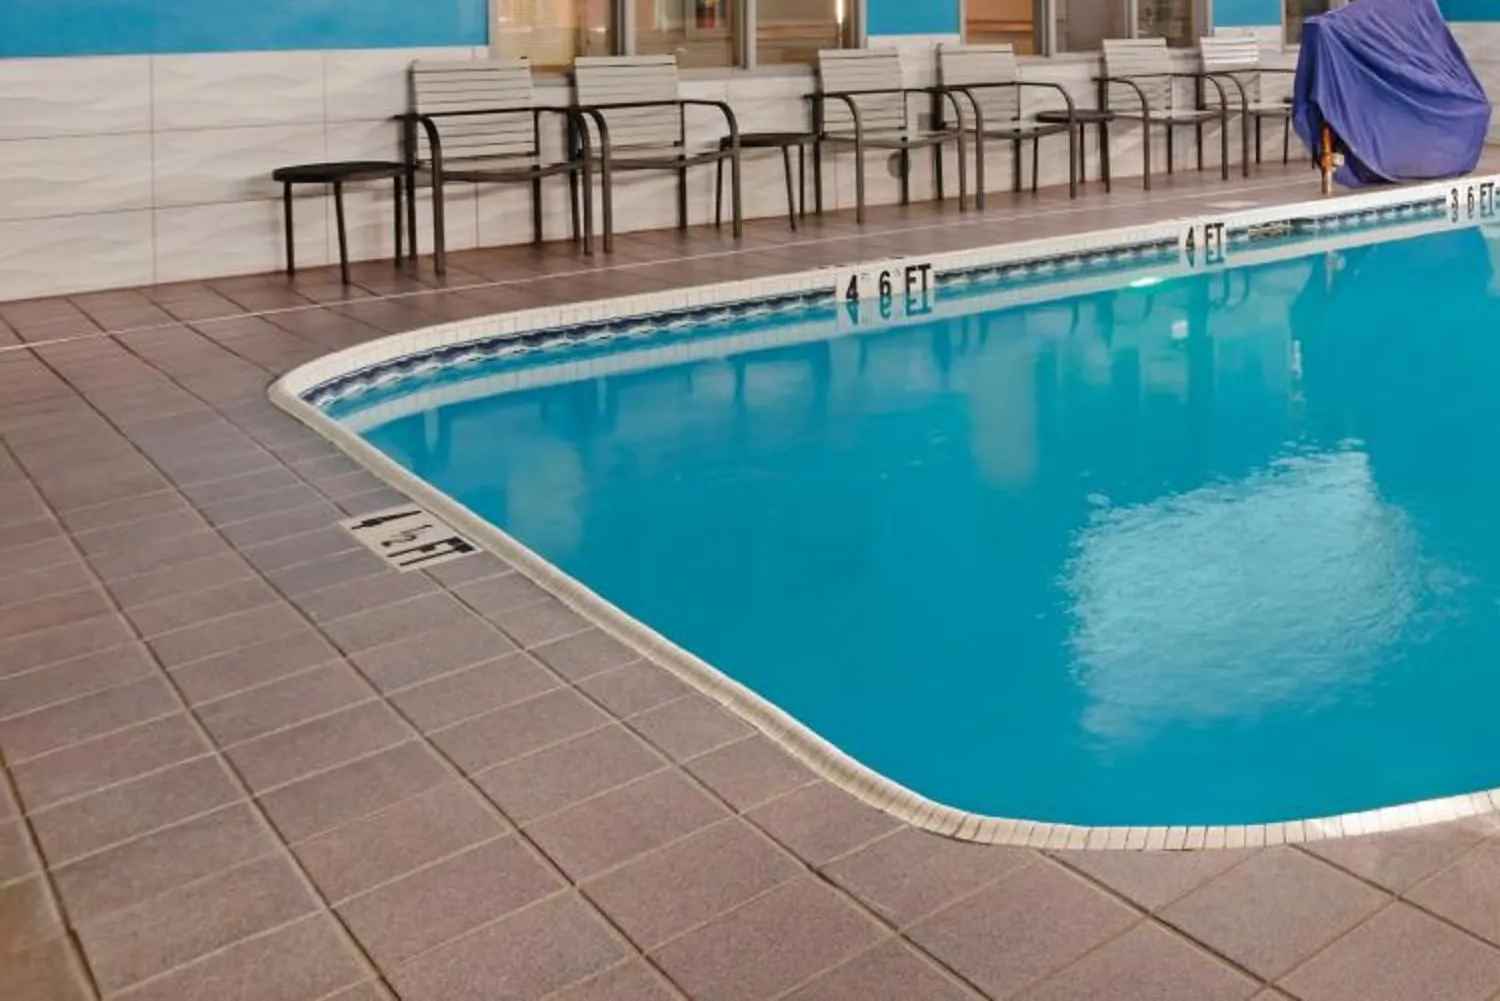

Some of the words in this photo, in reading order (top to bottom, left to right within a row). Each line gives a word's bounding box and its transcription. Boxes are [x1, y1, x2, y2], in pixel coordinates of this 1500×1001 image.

[1480, 182, 1494, 203] FT
[1185, 226, 1195, 249] 4
[1205, 222, 1224, 247] FT
[846, 274, 859, 300] 4
[879, 270, 891, 298] 6
[905, 263, 931, 295] FT
[386, 536, 476, 567] FT
